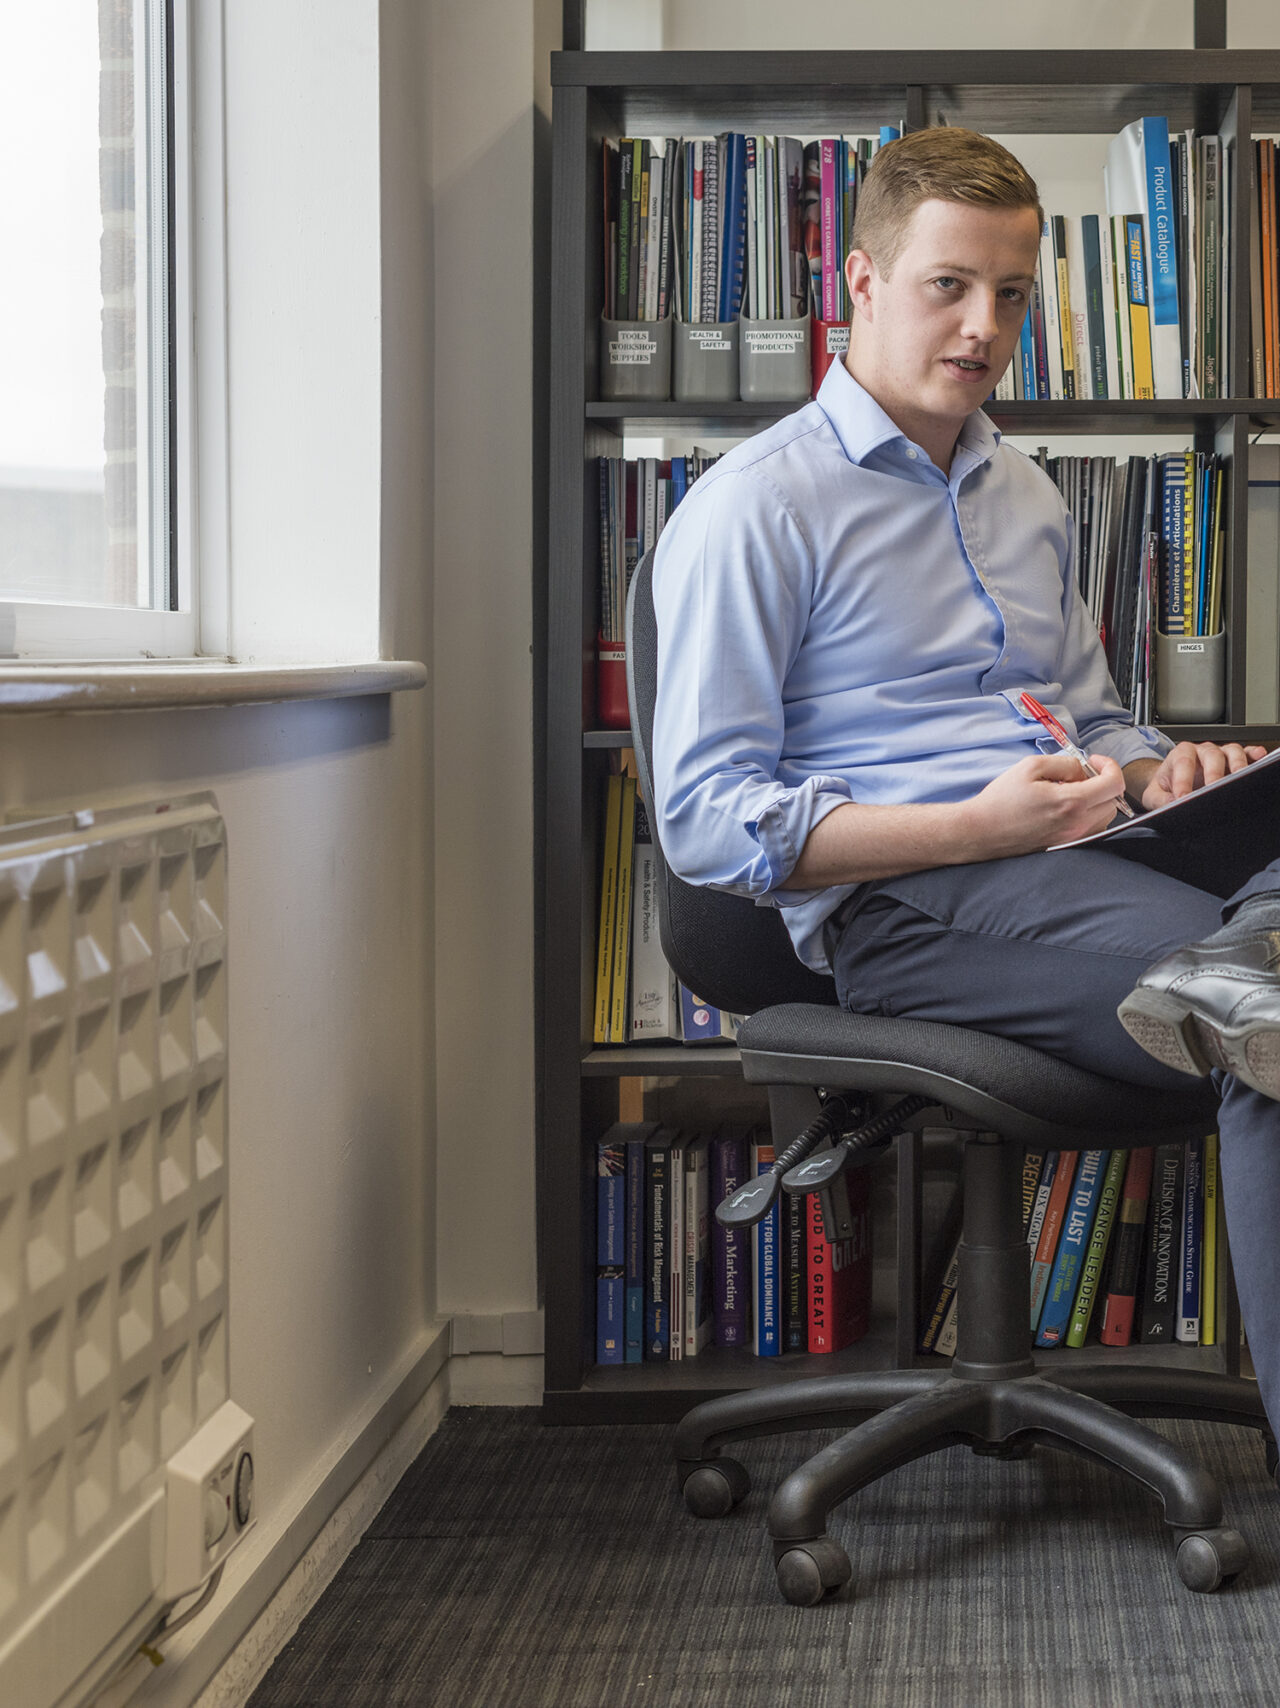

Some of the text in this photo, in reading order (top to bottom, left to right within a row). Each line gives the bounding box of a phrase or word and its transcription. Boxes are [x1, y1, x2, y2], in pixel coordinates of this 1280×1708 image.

[824, 146, 832, 164] 278
[1154, 166, 1170, 274] Product Catalogue
[824, 231, 832, 266] CATALOGUE
[1130, 240, 1141, 260] FAST
[746, 332, 803, 340] PROMOTIONAL
[1076, 314, 1086, 346] Direct
[612, 354, 649, 362] SUPPLIES
[1206, 356, 1215, 385] Jagger
[1171, 488, 1181, 613] Charnières et Articulations
[607, 1180, 615, 1198] Selling
[654, 1184, 664, 1232] Fundamentals
[1066, 1150, 1102, 1245] BUILT TO LAST
[1027, 1189, 1048, 1246] SIX SIGMA
[1042, 1210, 1057, 1260] Key Performance
[1154, 1160, 1179, 1303] DIFFUSION OF INNOVATIONS
[606, 1225, 614, 1260] Management
[654, 1242, 663, 1257] Risk
[686, 1232, 694, 1253] CRISIS
[1076, 1187, 1116, 1316] CHANGE LEADER
[1185, 1186, 1196, 1294] COMMUNICATION STYLE GUIDE
[652, 1258, 664, 1302] Management
[686, 1254, 694, 1297] MANAGEMENT
[724, 1246, 738, 1310] Marketing
[764, 1227, 774, 1327] FOR GLOBAL DOMINANCE
[814, 1244, 824, 1328] TO GREAT
[1030, 1265, 1045, 1308] Indicators
[1063, 1266, 1074, 1291] COLLINS
[922, 1314, 942, 1348] Harnish
